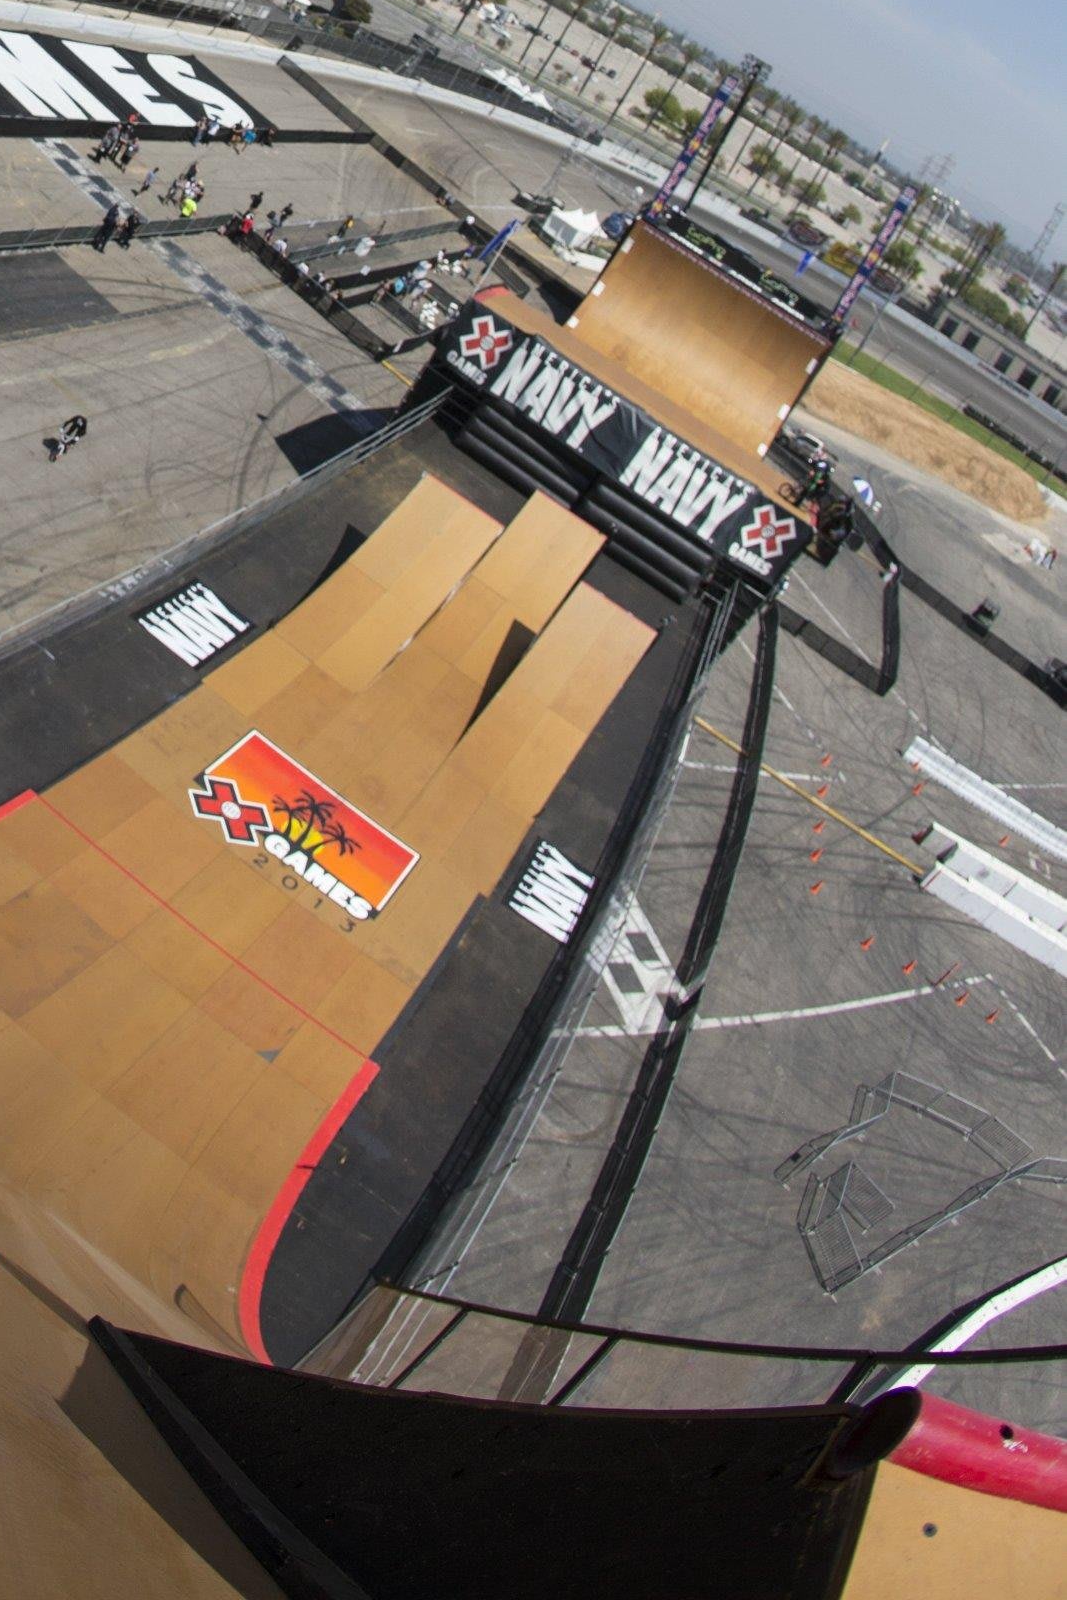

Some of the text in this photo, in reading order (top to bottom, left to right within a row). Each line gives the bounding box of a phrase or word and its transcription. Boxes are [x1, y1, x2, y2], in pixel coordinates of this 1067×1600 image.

[445, 350, 488, 386] GAMES
[489, 345, 619, 450] NAVY
[619, 436, 747, 542] NAVY
[727, 541, 773, 577] GAMES
[144, 589, 250, 668] NAVY
[253, 852, 356, 934] 2013
[264, 833, 373, 920] GAMES
[515, 843, 594, 944] NAVY
